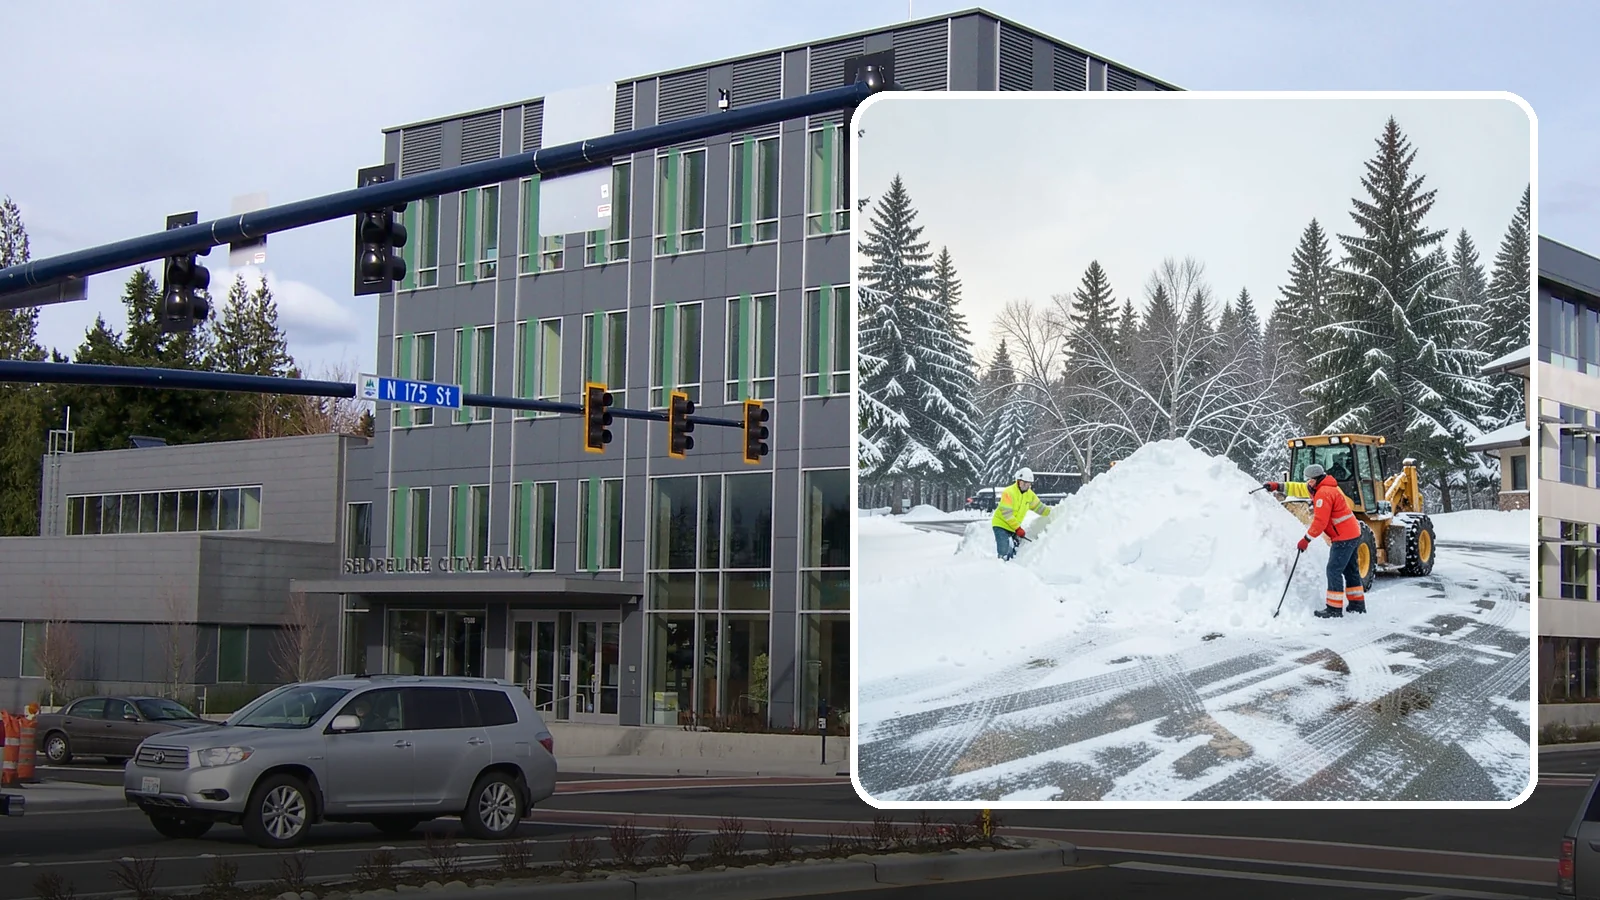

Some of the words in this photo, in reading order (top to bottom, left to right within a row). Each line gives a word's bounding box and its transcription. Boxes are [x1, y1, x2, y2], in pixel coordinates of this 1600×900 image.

[387, 381, 396, 399] N
[405, 382, 427, 403] 175
[436, 386, 451, 405] St
[344, 556, 431, 573] SHORELINE
[438, 556, 475, 573] CITY
[483, 555, 526, 572] HALL
